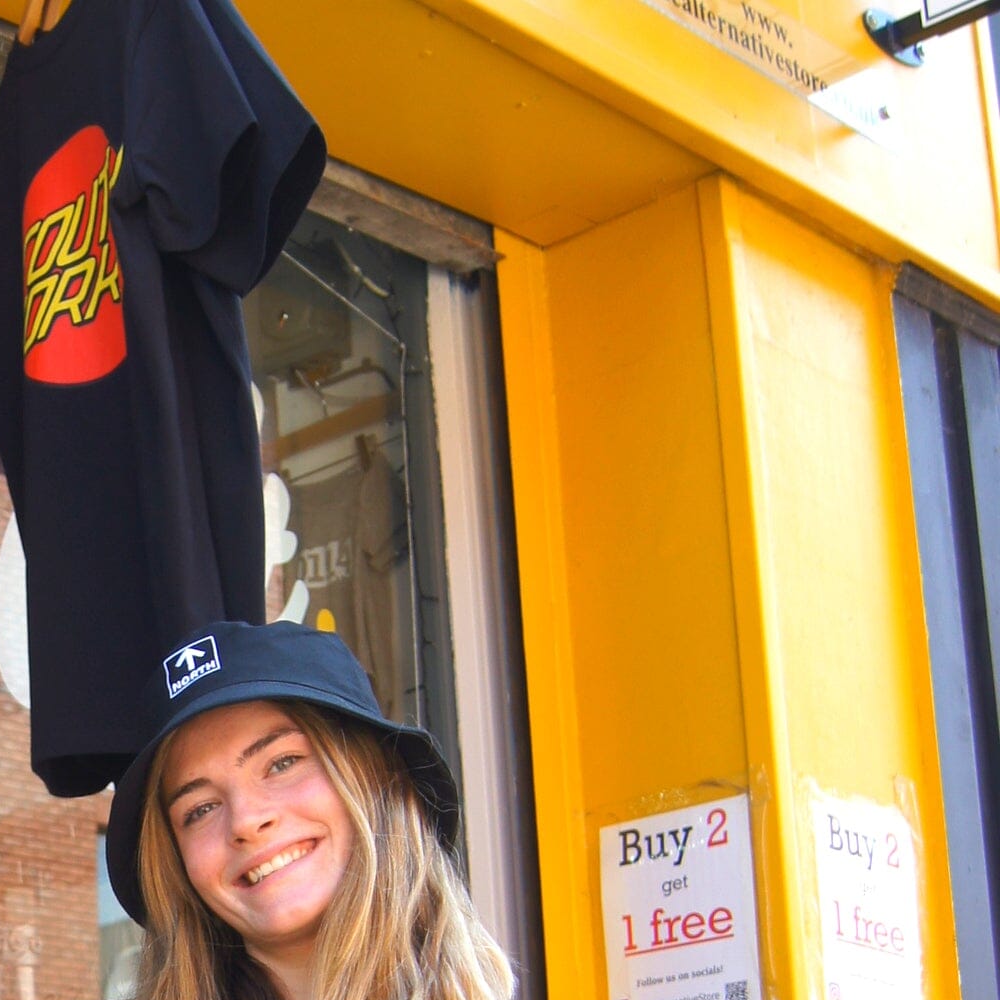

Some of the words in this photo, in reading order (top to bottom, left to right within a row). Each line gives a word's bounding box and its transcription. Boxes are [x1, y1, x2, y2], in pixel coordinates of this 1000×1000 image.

[741, 2, 793, 48] www.
[172, 660, 216, 692] NORTH
[619, 826, 693, 866] Buy
[707, 808, 728, 848] 2
[828, 813, 876, 870] Buy
[886, 832, 900, 868] 2
[662, 875, 688, 896] get
[622, 914, 637, 951] 1
[650, 907, 733, 946] free
[834, 900, 844, 936] 1
[854, 906, 904, 952] free
[636, 975, 665, 988] Follow
[666, 974, 676, 982] us
[678, 972, 689, 980] on
[691, 965, 723, 979] socials!
